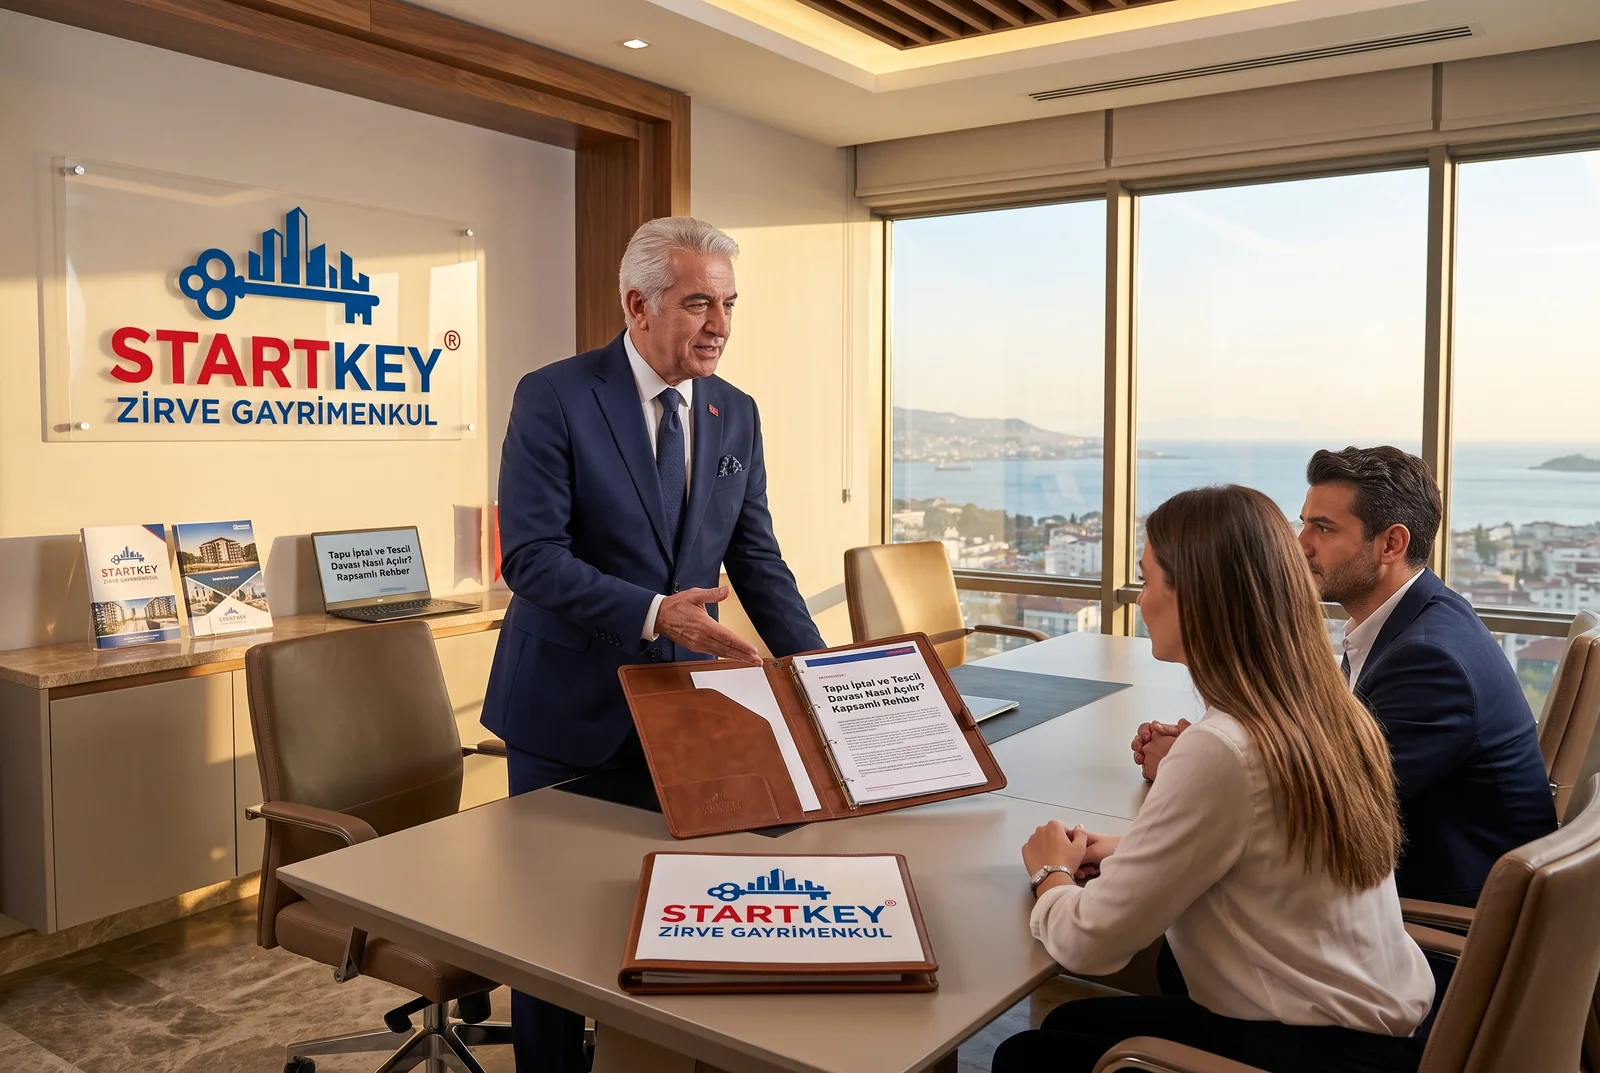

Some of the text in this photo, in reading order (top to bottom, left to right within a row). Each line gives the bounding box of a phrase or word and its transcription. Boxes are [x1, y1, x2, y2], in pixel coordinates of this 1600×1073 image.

[117, 390, 438, 426] ZİRVE GAYRİMENKUL
[328, 551, 351, 560] Tapu
[352, 547, 373, 558] İptal
[386, 544, 411, 554] Tescil
[331, 555, 412, 570] Davası Nasıl Açılır?
[101, 565, 158, 578] STARTKEY
[379, 567, 410, 577] Rehber
[823, 672, 921, 694] Tapu İptal ve Tescil
[827, 682, 925, 703] Davası Nasıl Açılır?
[831, 695, 920, 713] Kapsamlı Rehber
[658, 924, 893, 939] ZİRVE GAYRİMENKUL
